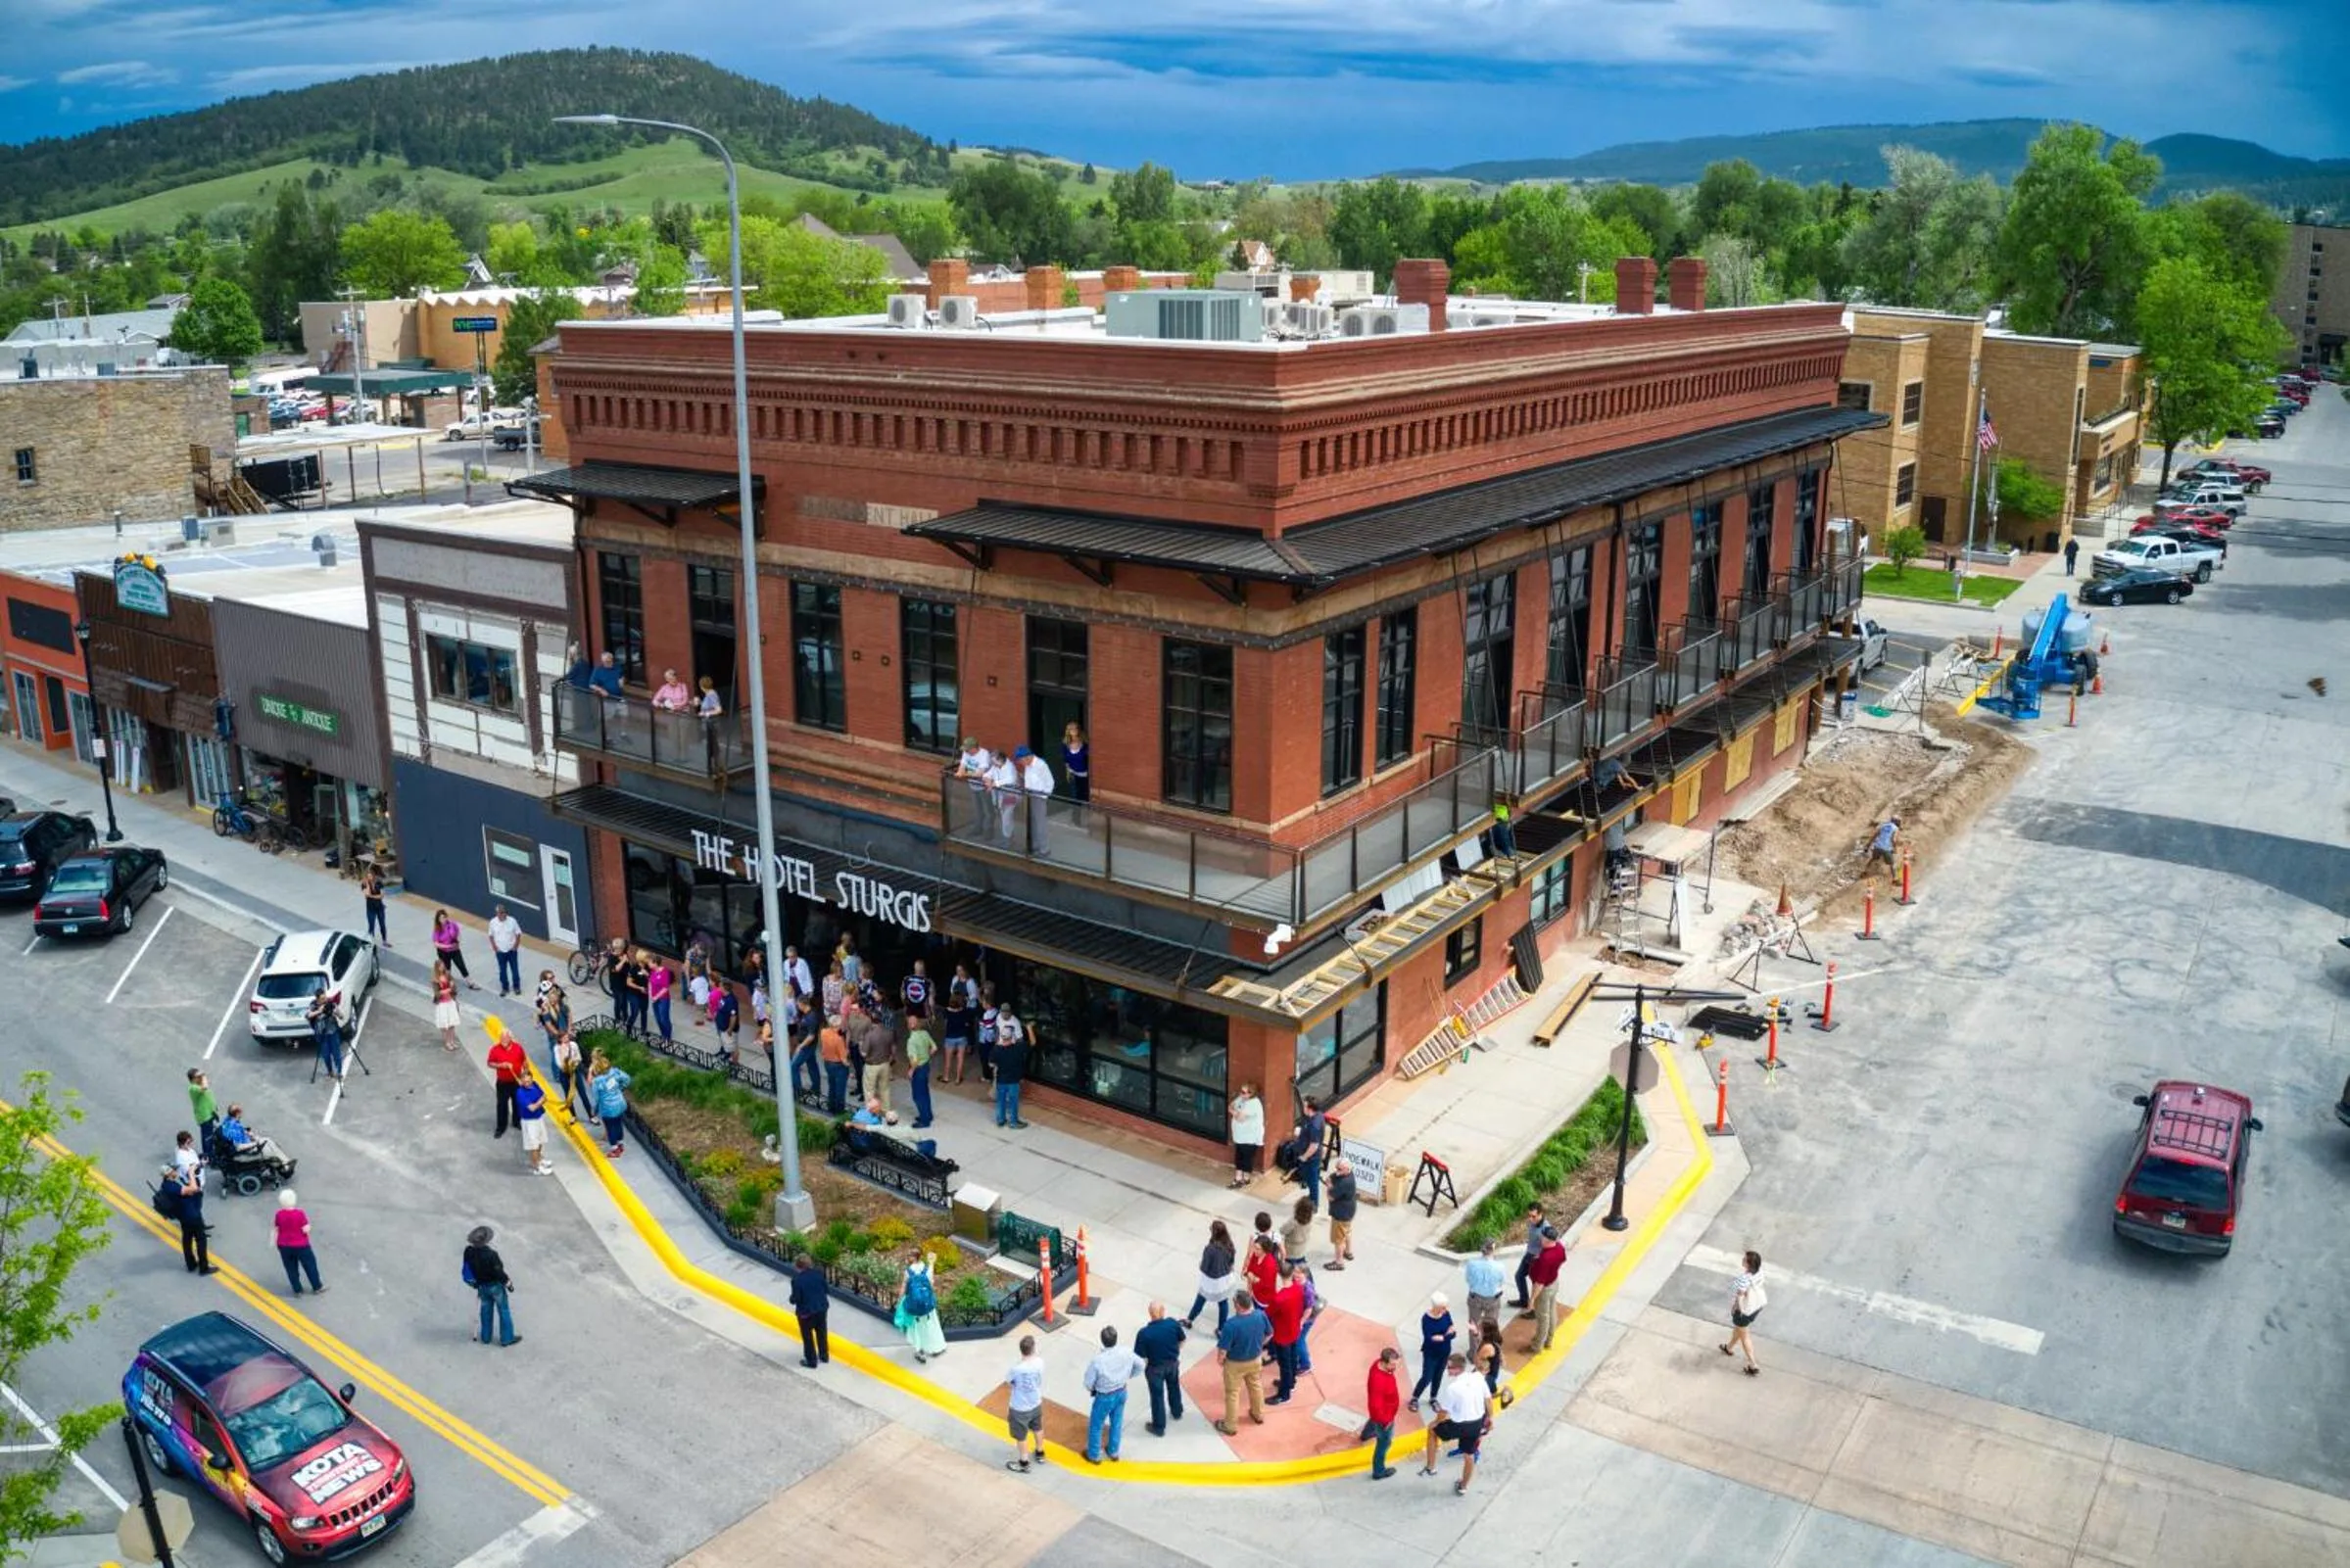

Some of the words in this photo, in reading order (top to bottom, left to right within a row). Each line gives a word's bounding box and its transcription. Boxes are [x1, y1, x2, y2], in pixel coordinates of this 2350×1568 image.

[691, 830, 736, 876] THE
[836, 871, 931, 933] STURGIS
[291, 1442, 370, 1487] KOTA
[309, 1458, 383, 1505] NEWS
